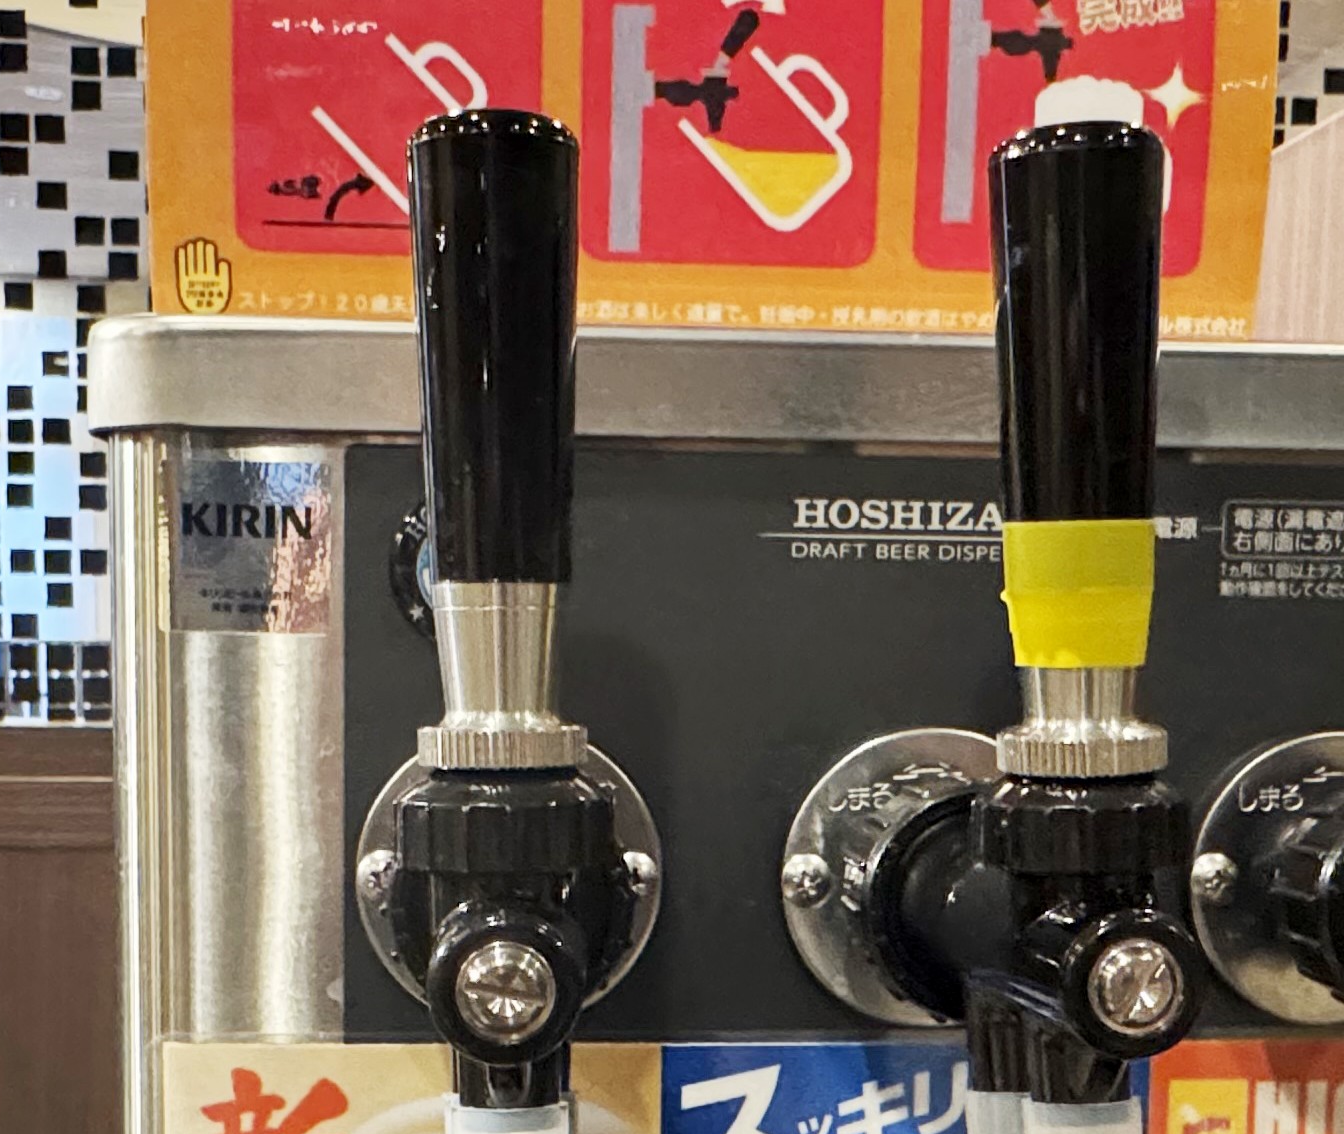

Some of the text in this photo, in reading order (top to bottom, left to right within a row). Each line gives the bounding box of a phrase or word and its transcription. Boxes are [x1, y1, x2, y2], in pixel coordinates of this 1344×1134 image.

[181, 503, 312, 539] KIRIN
[791, 541, 867, 559] DRAFT
[875, 543, 930, 560] BEER
[828, 782, 896, 812] しまる
[1238, 784, 1304, 812] しまる
